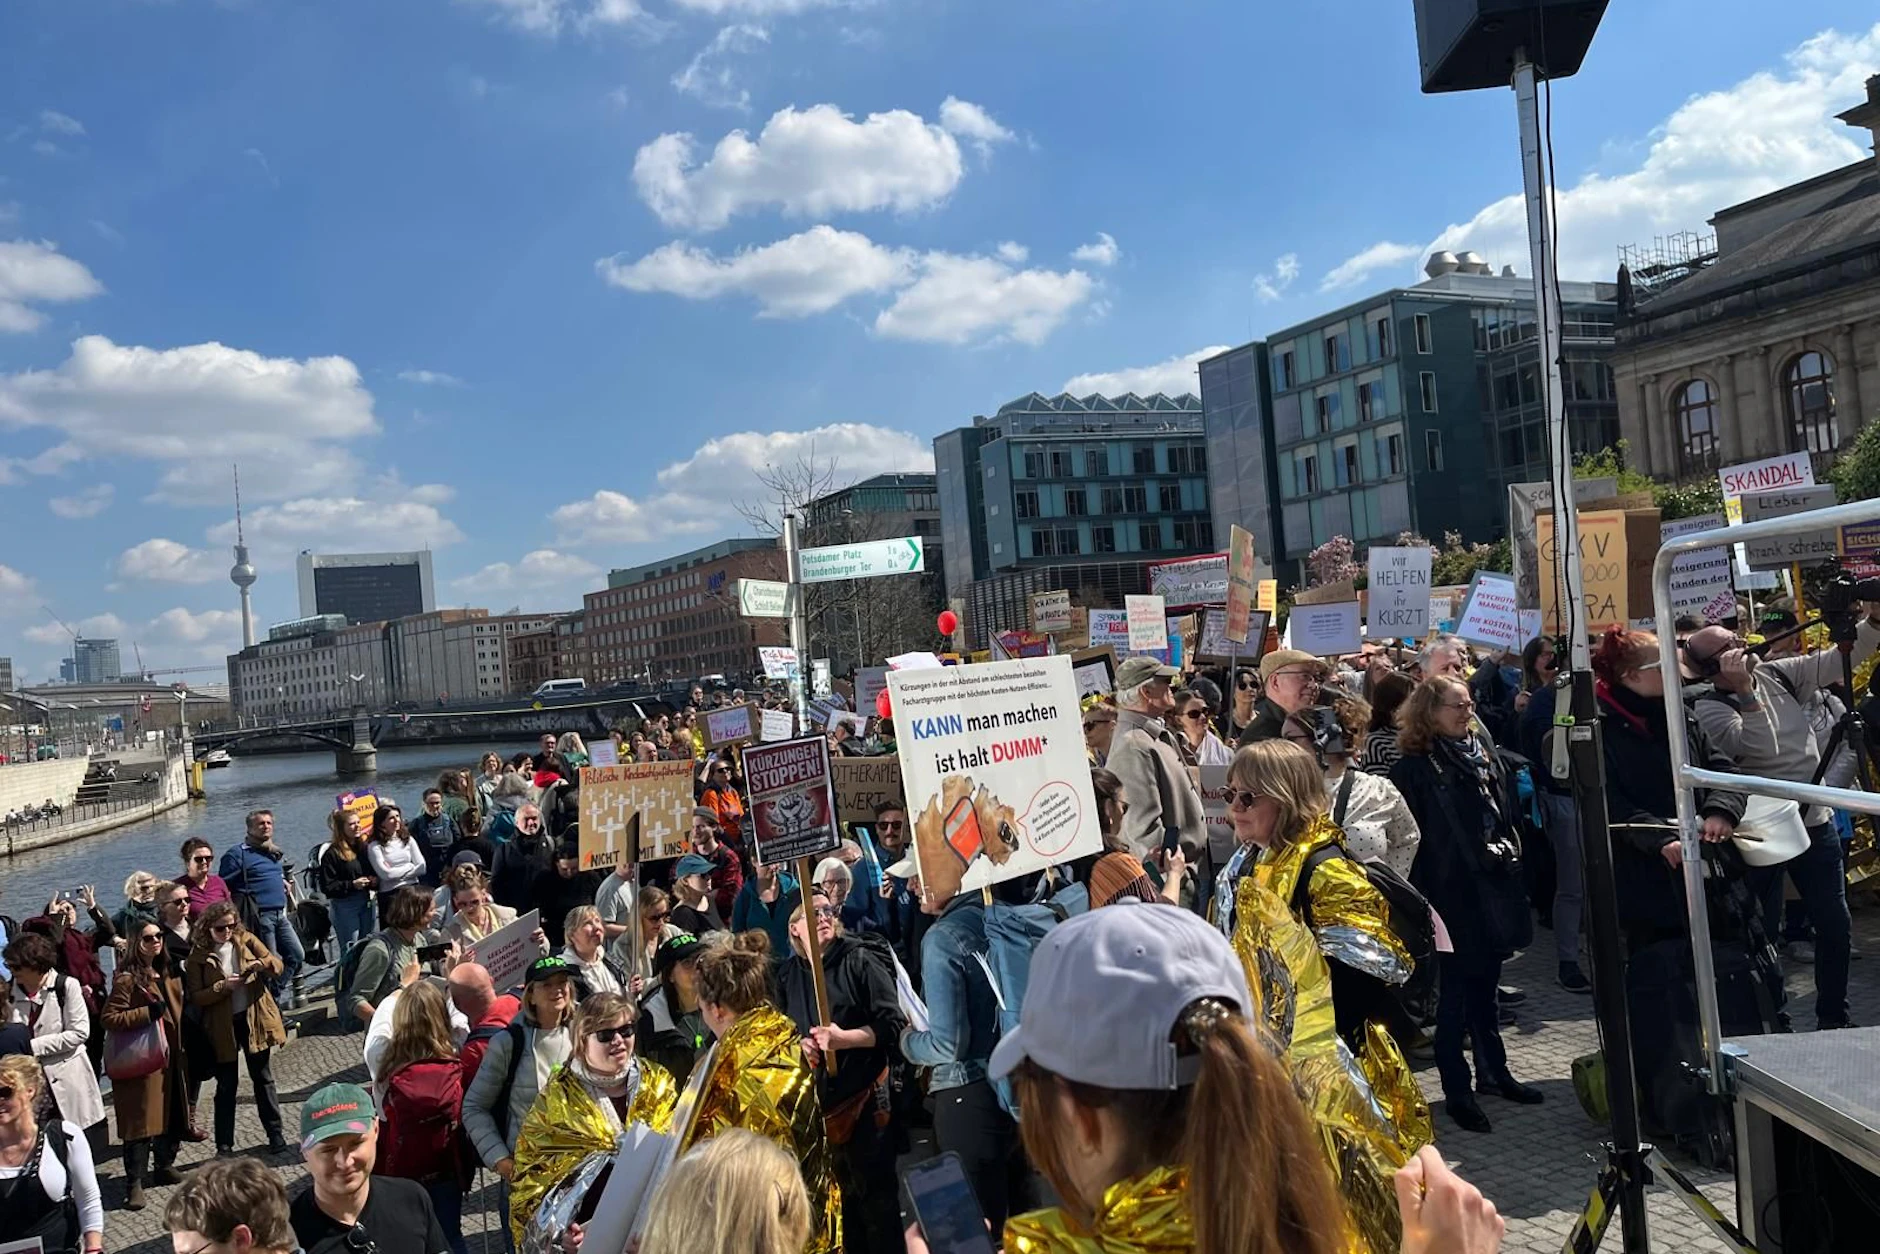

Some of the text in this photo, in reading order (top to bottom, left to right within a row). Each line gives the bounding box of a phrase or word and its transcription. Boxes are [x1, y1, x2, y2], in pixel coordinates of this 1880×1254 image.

[801, 553, 840, 565] Potsdamer
[842, 550, 862, 560] Platz
[803, 564, 857, 578] Brandenburger
[859, 562, 873, 572] Tor
[1376, 569, 1426, 586] HELFEN
[1393, 595, 1406, 606] ihr
[1478, 601, 1509, 613] MANGEL
[1483, 618, 1513, 631] KOSTEN
[900, 680, 931, 692] Kürzungen
[932, 680, 938, 688] in
[939, 679, 948, 688] der
[949, 677, 958, 686] mit
[959, 675, 981, 685] Abstand
[990, 672, 1023, 682] schlechtesten
[1023, 669, 1047, 679] bezahlten
[902, 694, 946, 707] Facharztgruppe
[947, 692, 956, 700] mit
[957, 690, 966, 699] der
[967, 688, 991, 699] höchsten
[912, 702, 1057, 740] KANN man machen
[748, 743, 820, 774] KÜRZUNGEN
[935, 752, 955, 774] ist
[958, 745, 990, 770] halt
[751, 757, 822, 792] STOPPEN!
[832, 763, 898, 783] OTHERAPIE
[590, 850, 620, 868] NICHT
[639, 846, 655, 860] MIT
